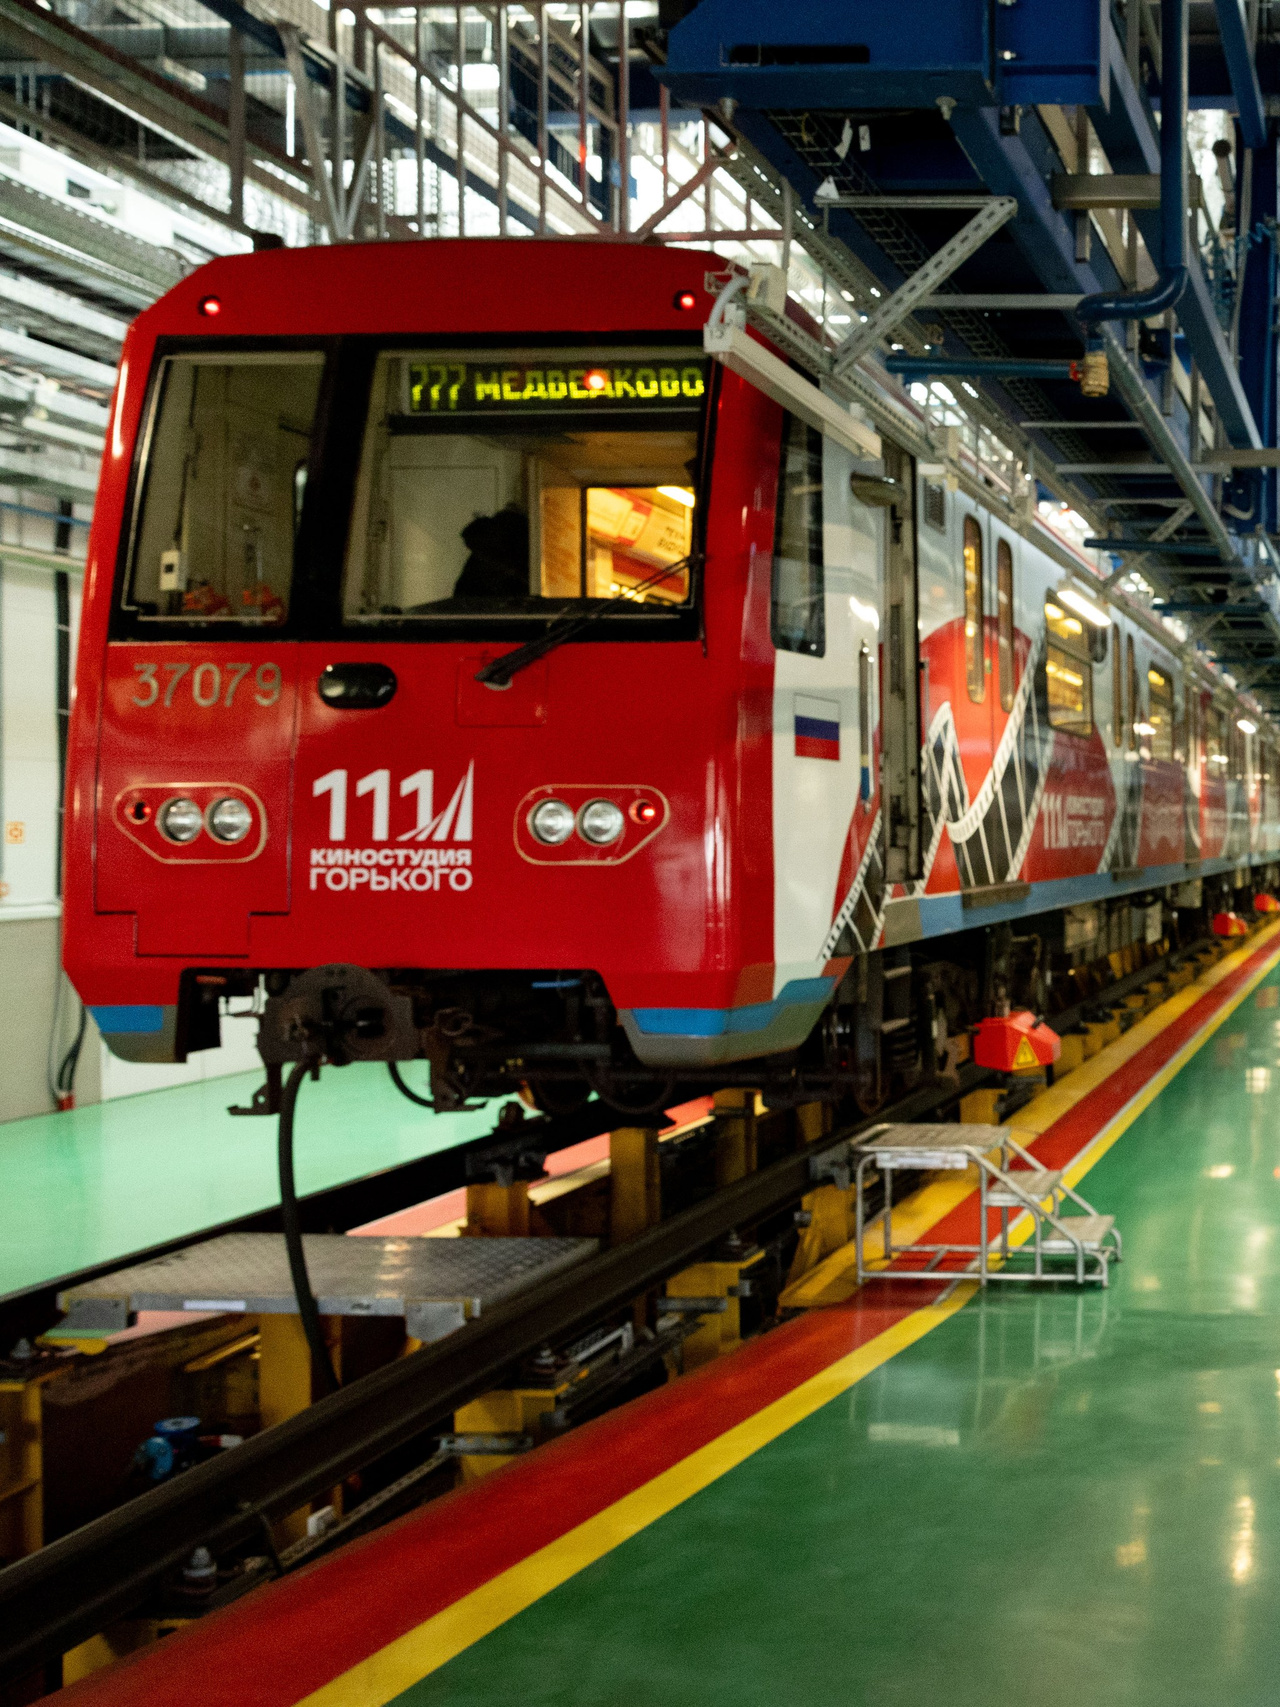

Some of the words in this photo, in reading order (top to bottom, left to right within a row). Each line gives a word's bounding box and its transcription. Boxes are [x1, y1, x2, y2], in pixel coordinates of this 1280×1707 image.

[132, 662, 282, 707] 37079
[310, 848, 472, 868] КИНОСТУДИЯ
[309, 867, 473, 891] ГОРЬКОГО
